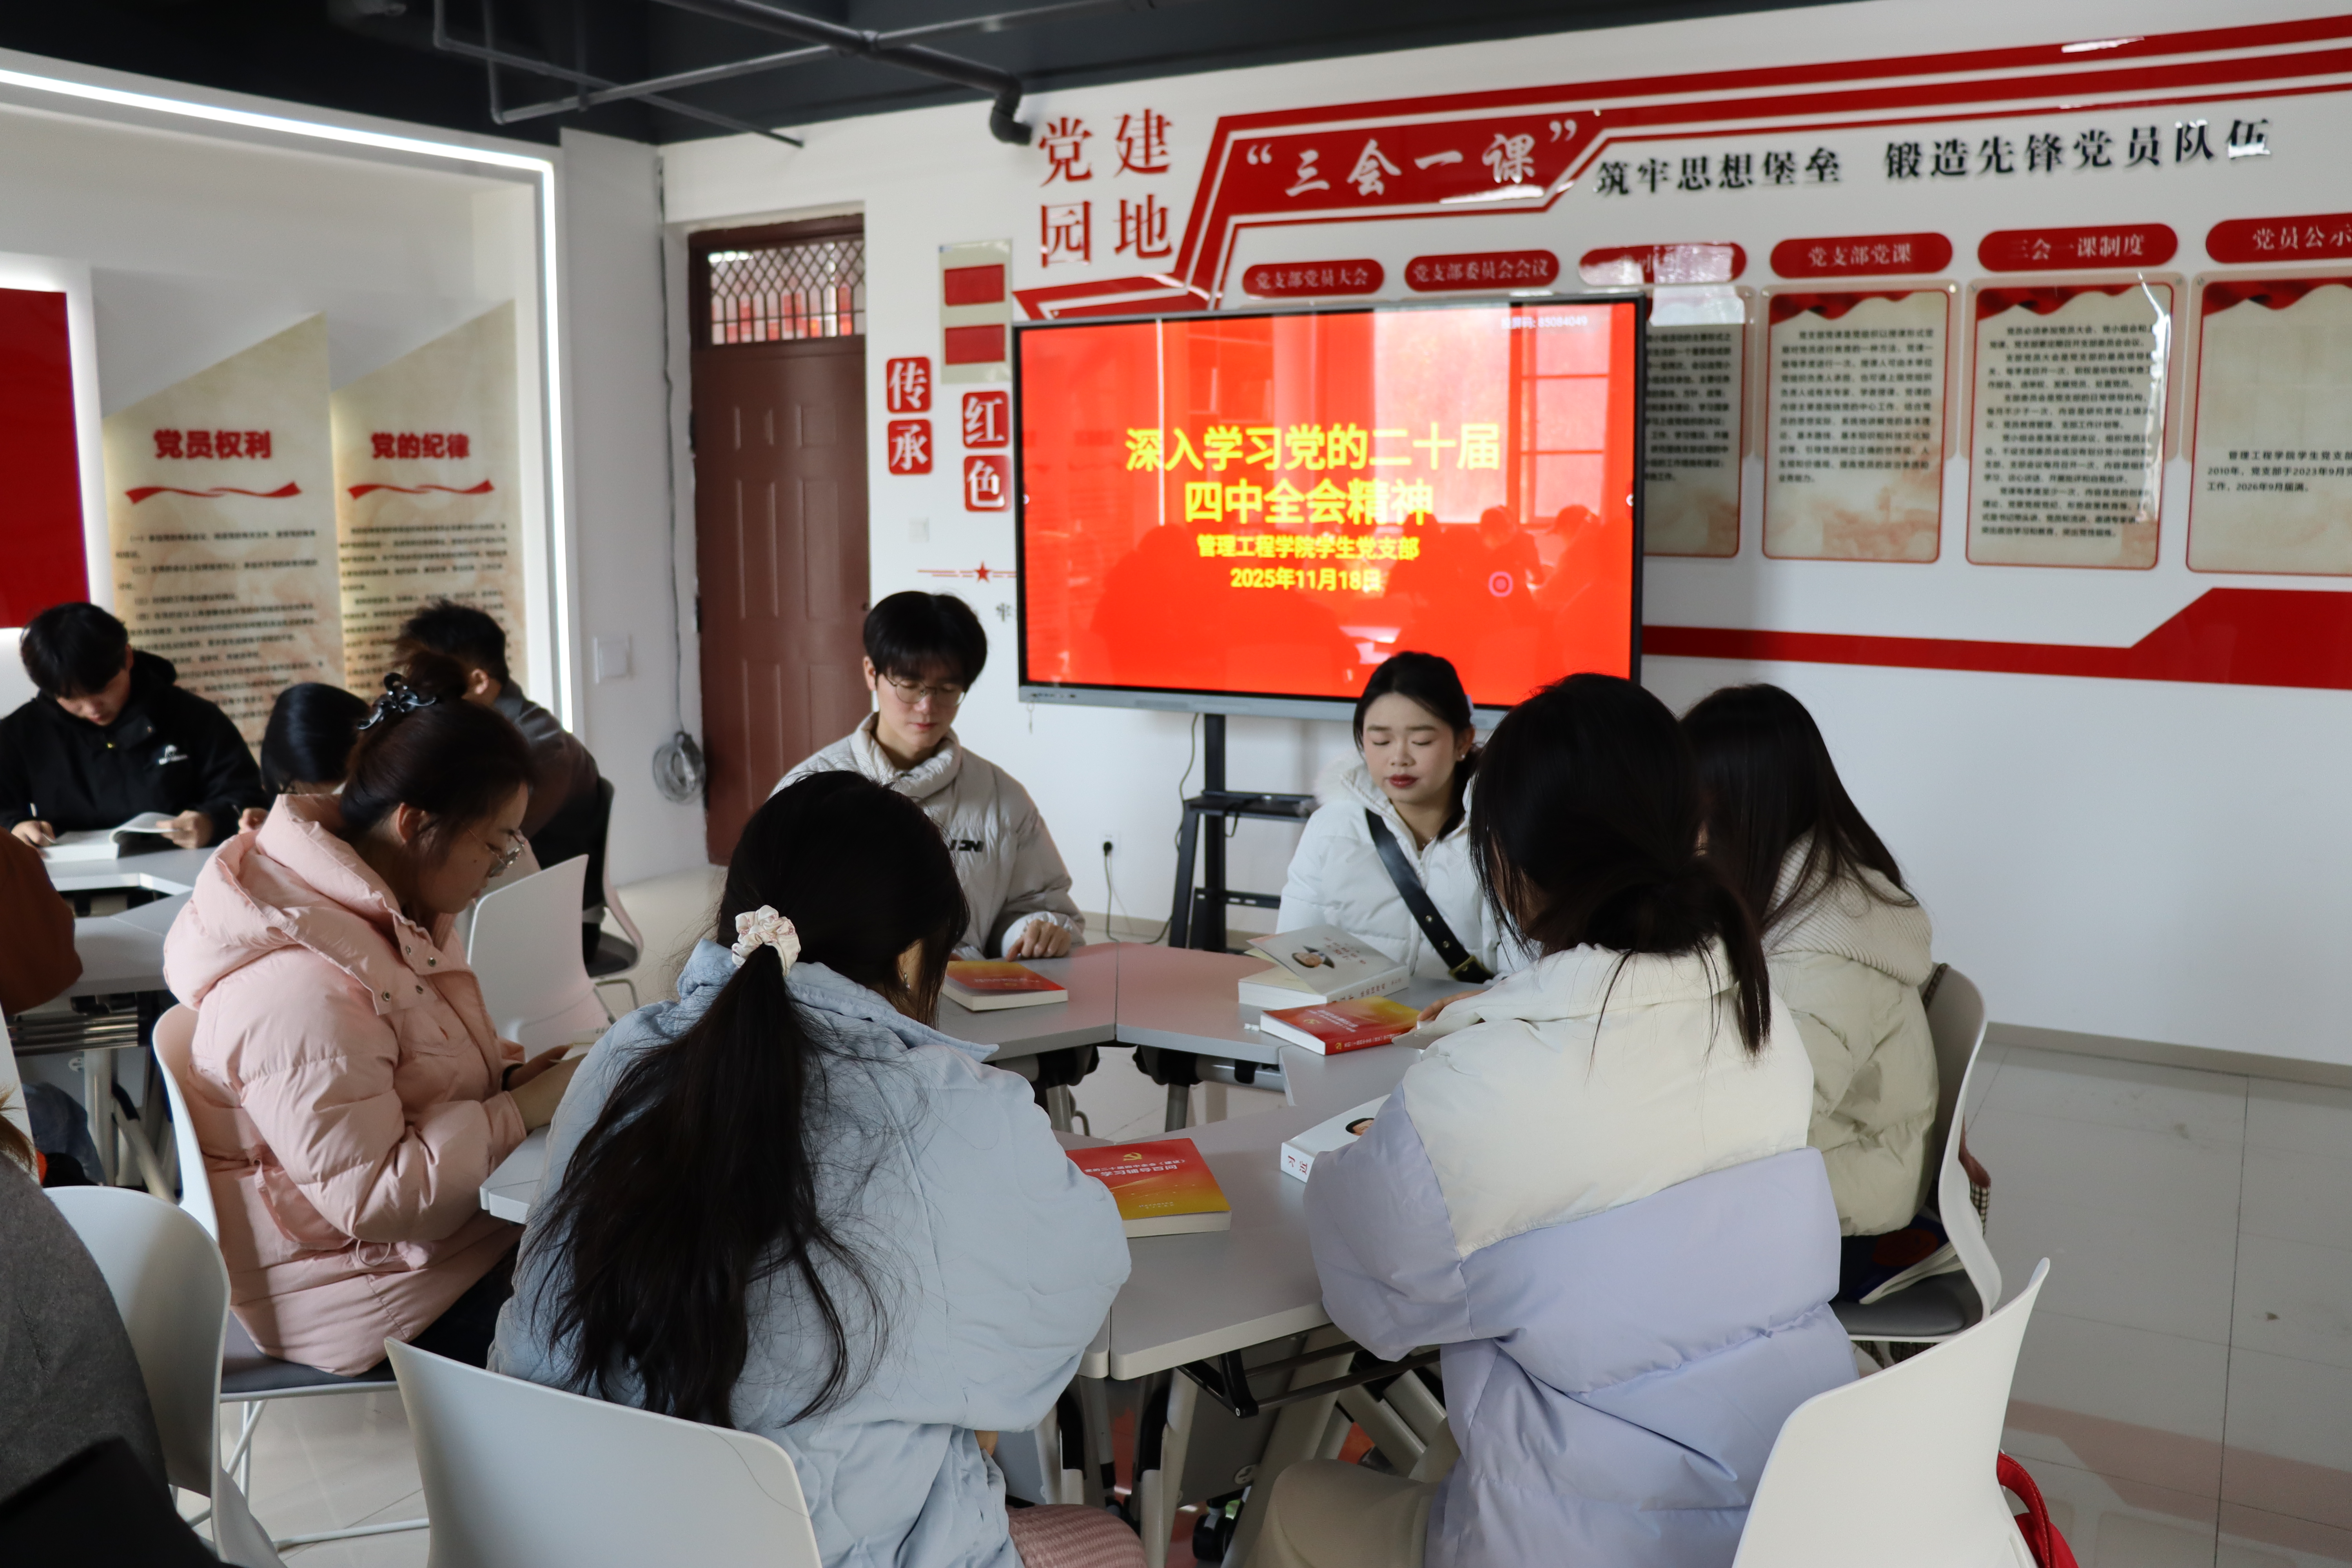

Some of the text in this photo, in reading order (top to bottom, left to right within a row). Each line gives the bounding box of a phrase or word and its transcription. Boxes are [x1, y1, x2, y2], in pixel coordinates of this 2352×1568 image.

[1595, 118, 2272, 197] 筑牢思想堡垒 锻造先锋党员队伍
[2010, 232, 2145, 260] 三会一课制度
[2252, 223, 2352, 250] 党员公示
[1808, 242, 1912, 267] 党支部党课
[1255, 267, 1368, 290] 党支部党员大会
[1413, 258, 1549, 283] 党支部委员会会议
[154, 429, 272, 459] 党员权利
[371, 433, 469, 459] 党的纪律
[1125, 422, 1501, 472] 深入学习党的二十届
[1184, 480, 1433, 526] 四中全会精神
[1197, 534, 1420, 560] 管理工程学院学生党支部
[1231, 568, 1381, 592] 2025年11月18日
[1085, 1159, 1185, 1172] 党的二十届四中全会《建议》
[1100, 1165, 1178, 1177] 学习辅导百问
